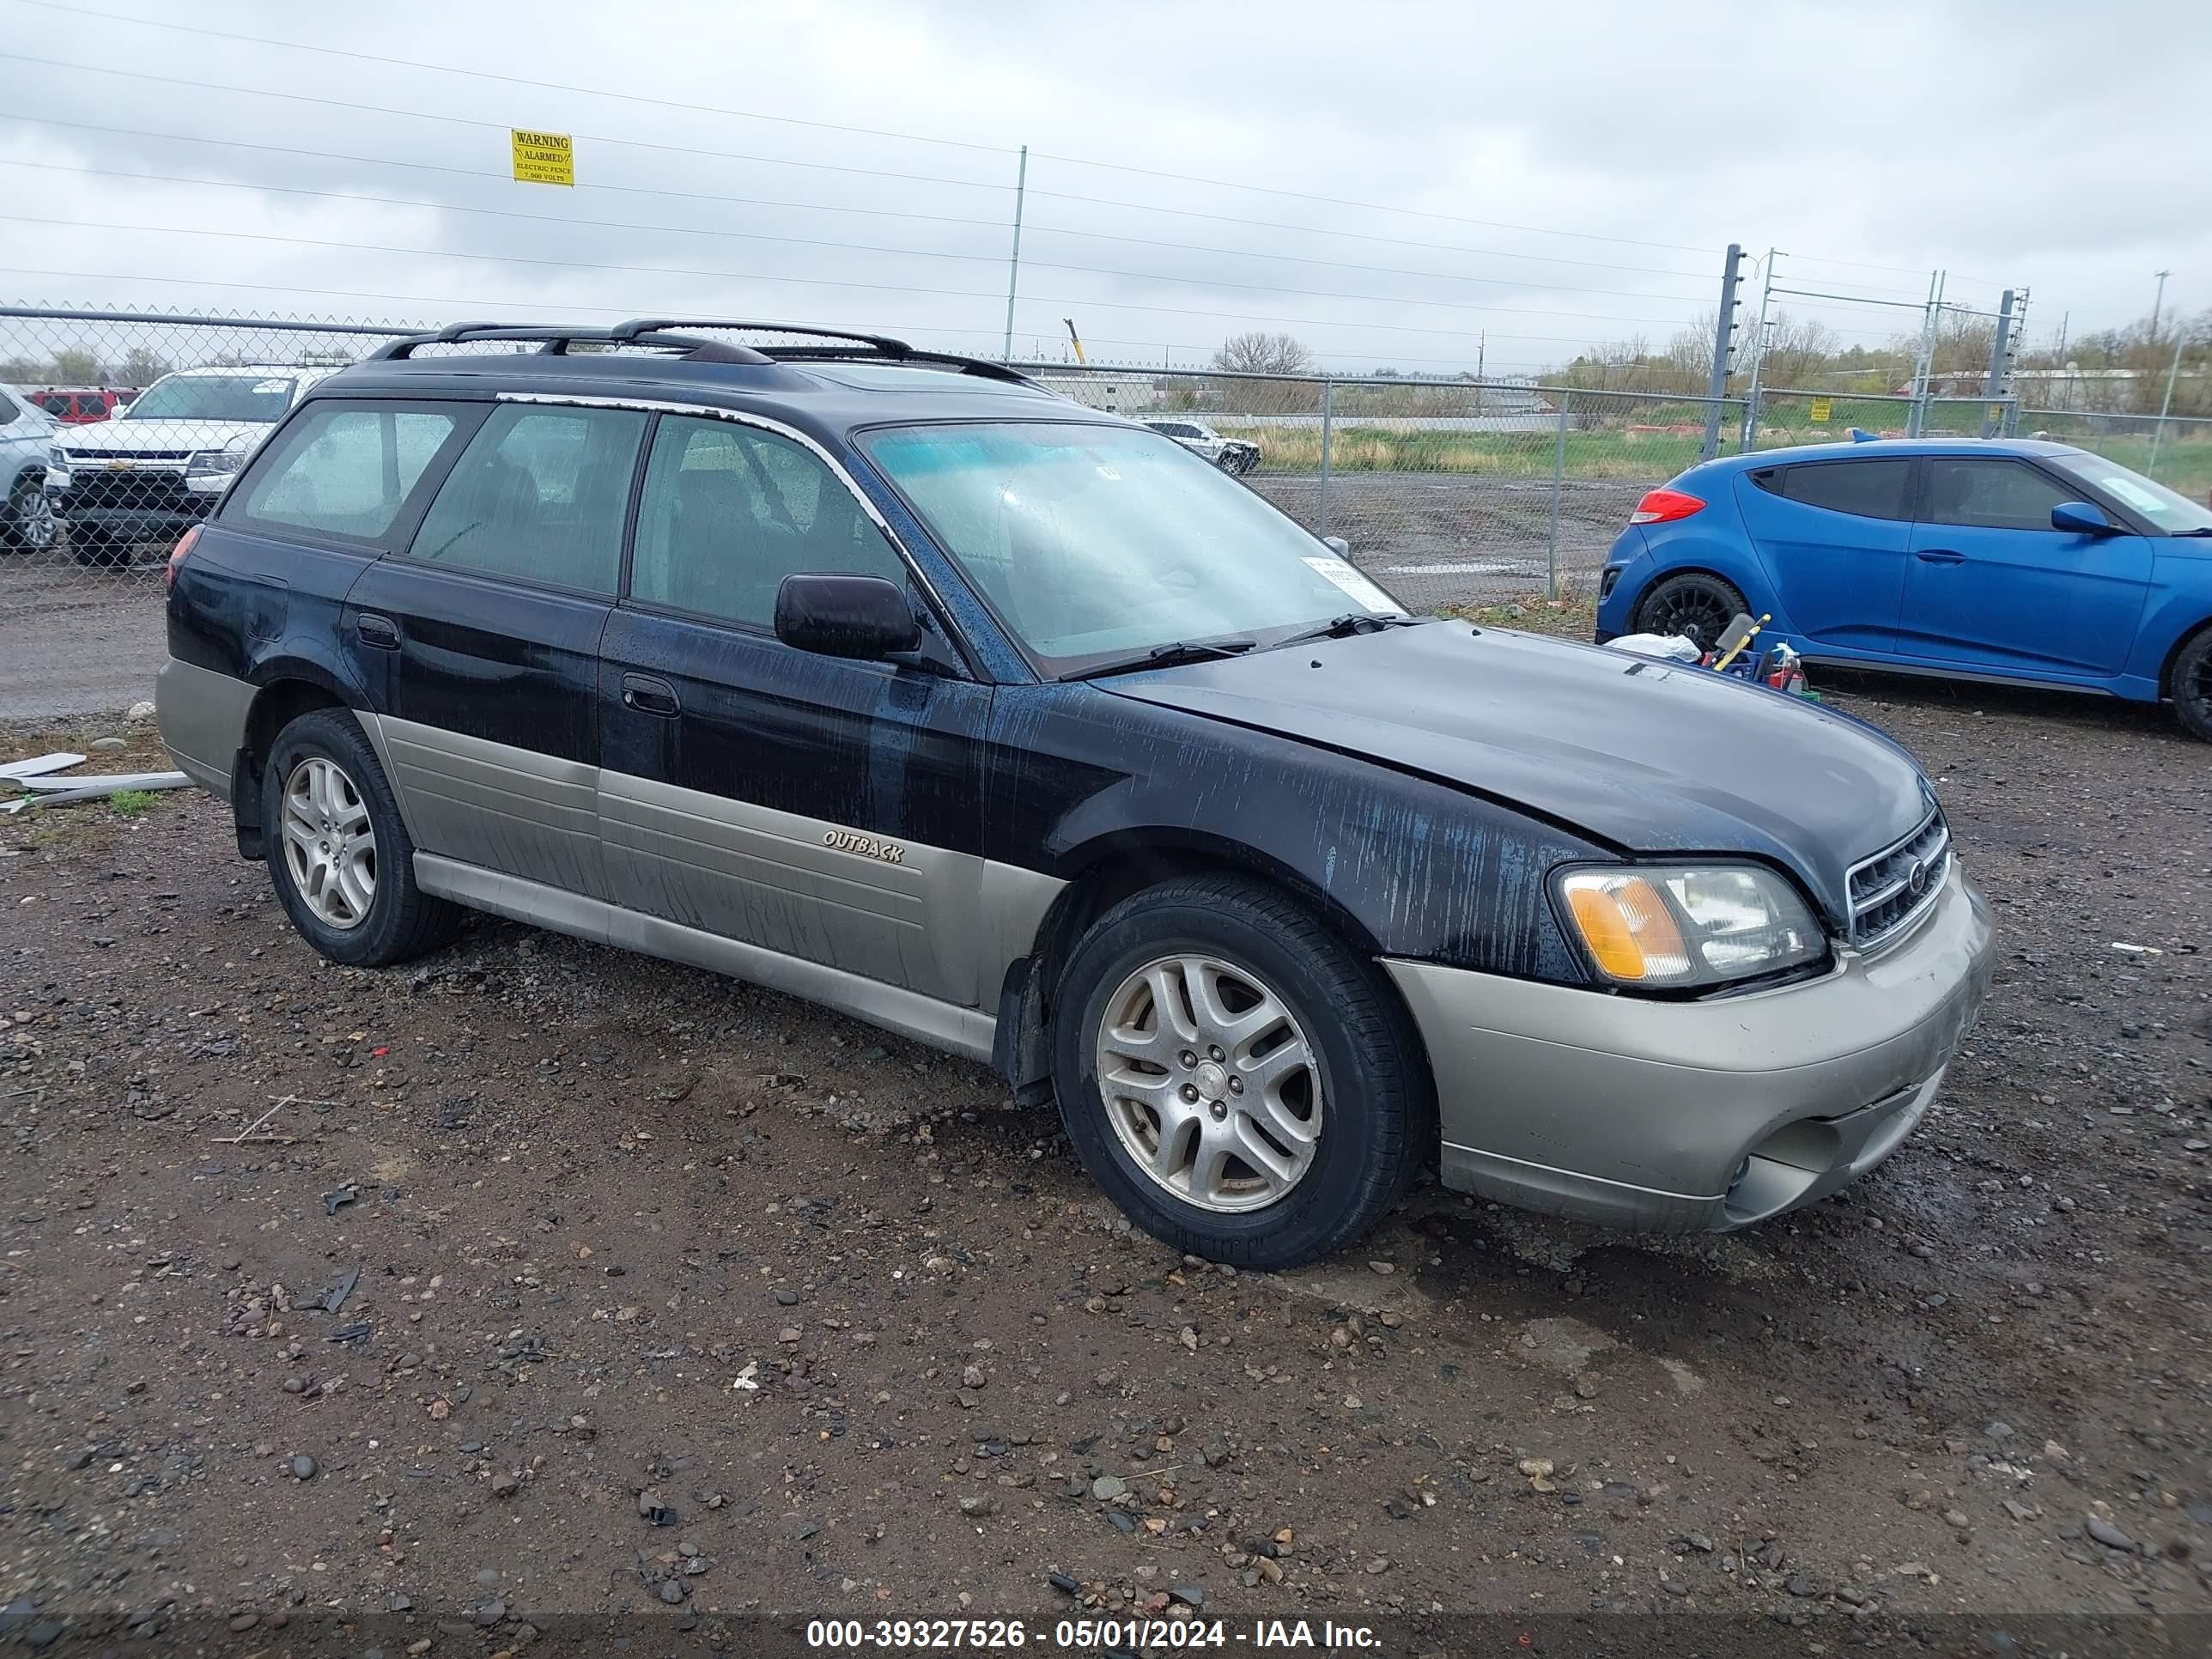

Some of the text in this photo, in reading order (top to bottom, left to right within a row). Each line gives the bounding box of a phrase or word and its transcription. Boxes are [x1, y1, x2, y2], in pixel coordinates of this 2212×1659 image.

[516, 132, 568, 149] WARNING
[524, 150, 563, 163] ALARMED
[517, 163, 549, 172] ELECTRIC
[823, 830, 904, 862] OUTBACK
